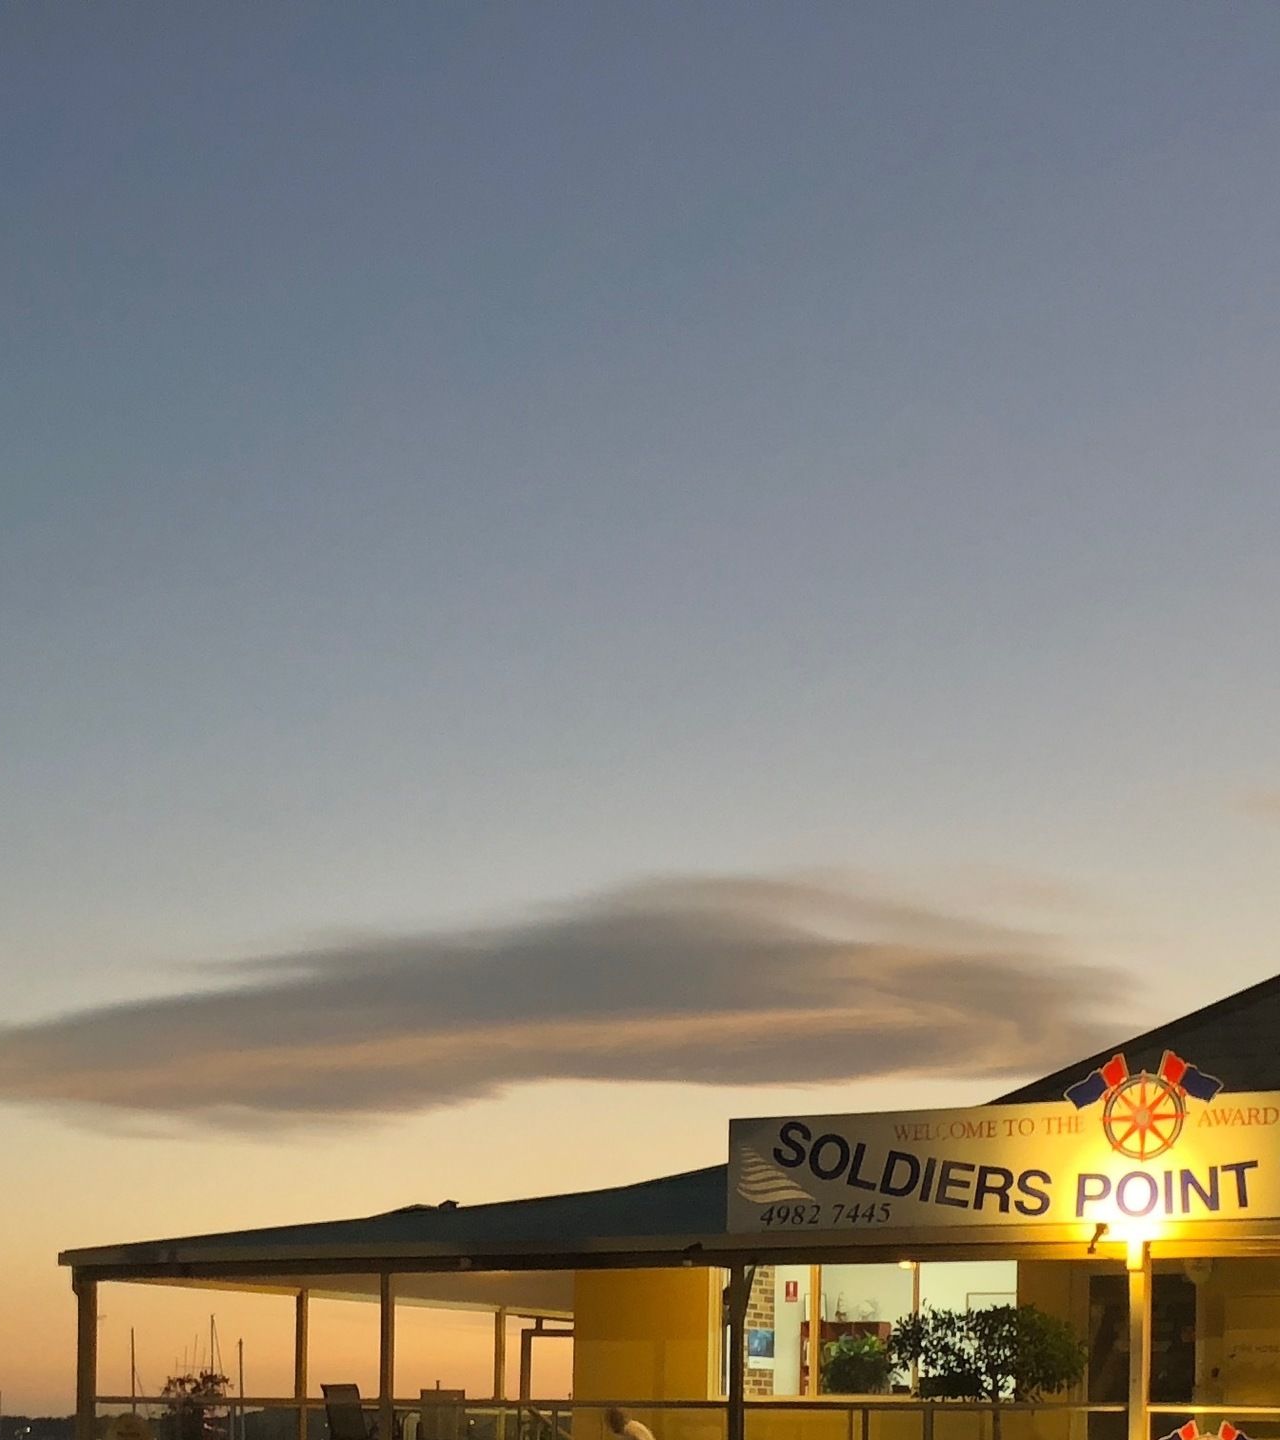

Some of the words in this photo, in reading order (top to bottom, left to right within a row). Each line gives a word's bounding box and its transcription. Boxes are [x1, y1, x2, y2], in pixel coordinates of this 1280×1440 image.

[894, 1120, 999, 1142] WELCOME
[1003, 1118, 1035, 1137] TO
[1041, 1115, 1085, 1135] THE
[1198, 1106, 1279, 1127] AWARD
[773, 1121, 1052, 1217] SOLDIERS
[1075, 1160, 1259, 1218] POINT
[760, 1205, 820, 1226] 4982
[832, 1203, 892, 1224] 7445
